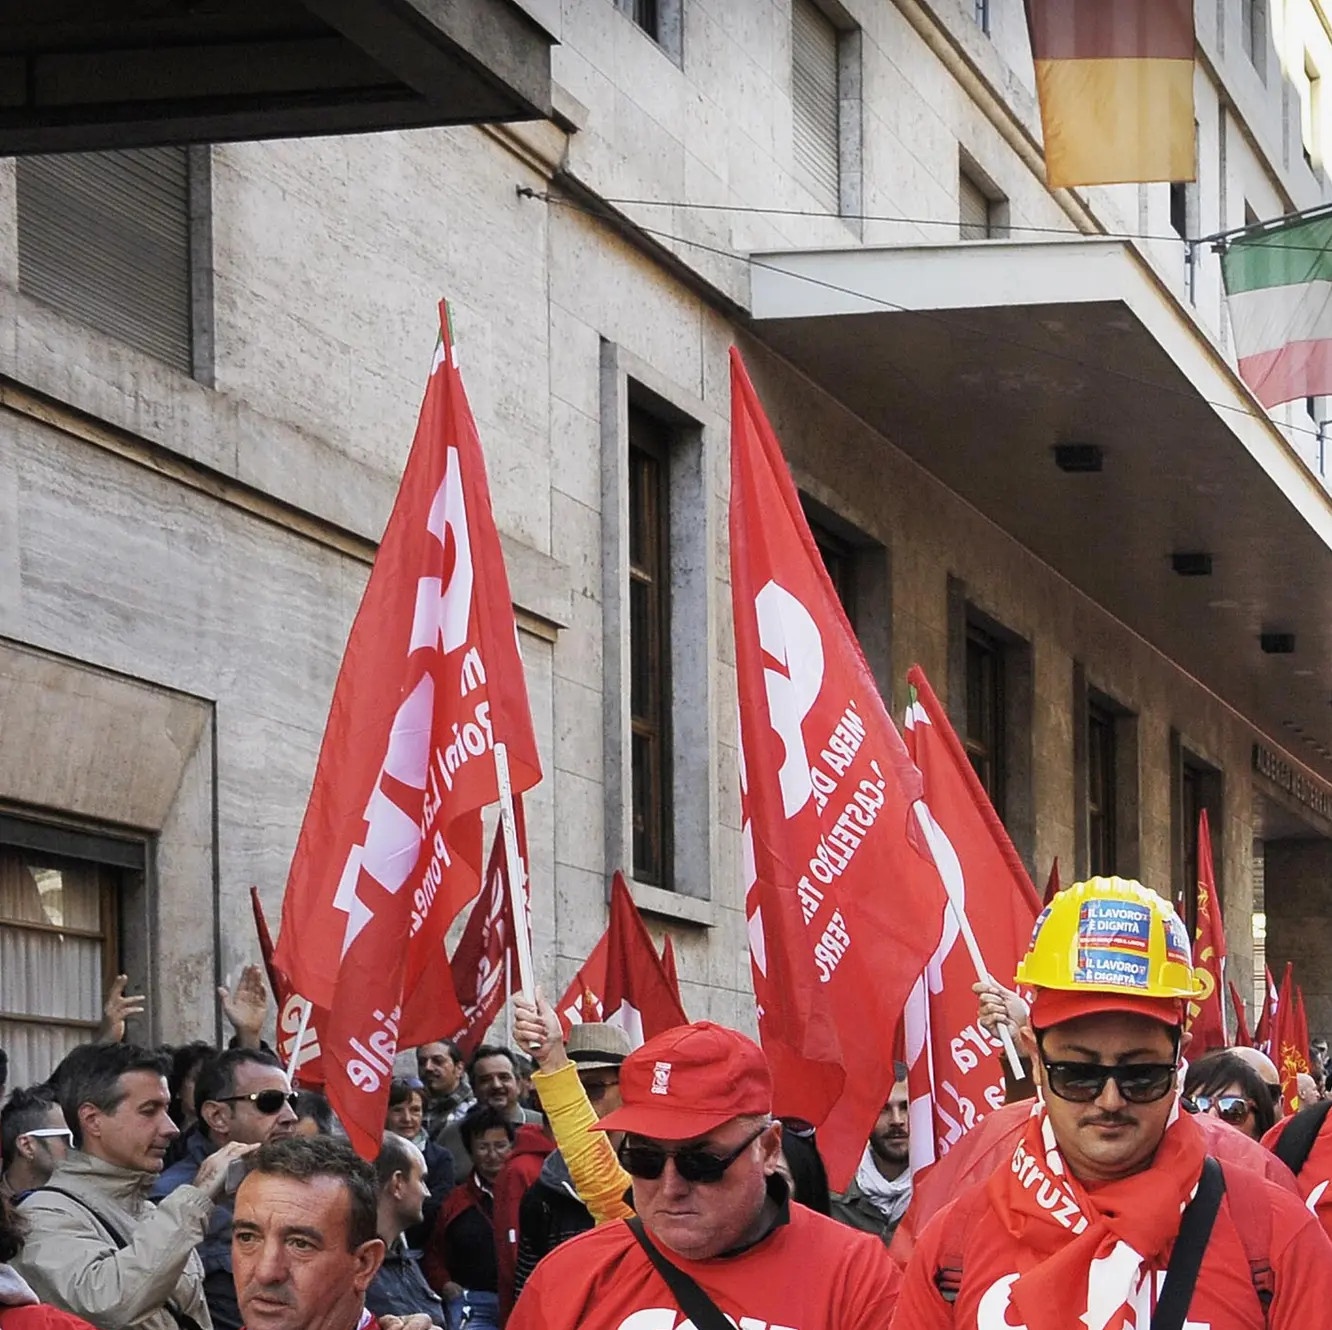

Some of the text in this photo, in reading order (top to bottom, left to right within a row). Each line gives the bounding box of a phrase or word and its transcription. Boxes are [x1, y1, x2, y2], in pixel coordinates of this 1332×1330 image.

[1088, 908, 1141, 921] IL LAVORO
[1089, 919, 1140, 933] È DIGNITÀ
[1086, 959, 1139, 973] IL LAVORO
[1094, 971, 1135, 984] DIGNITÀ
